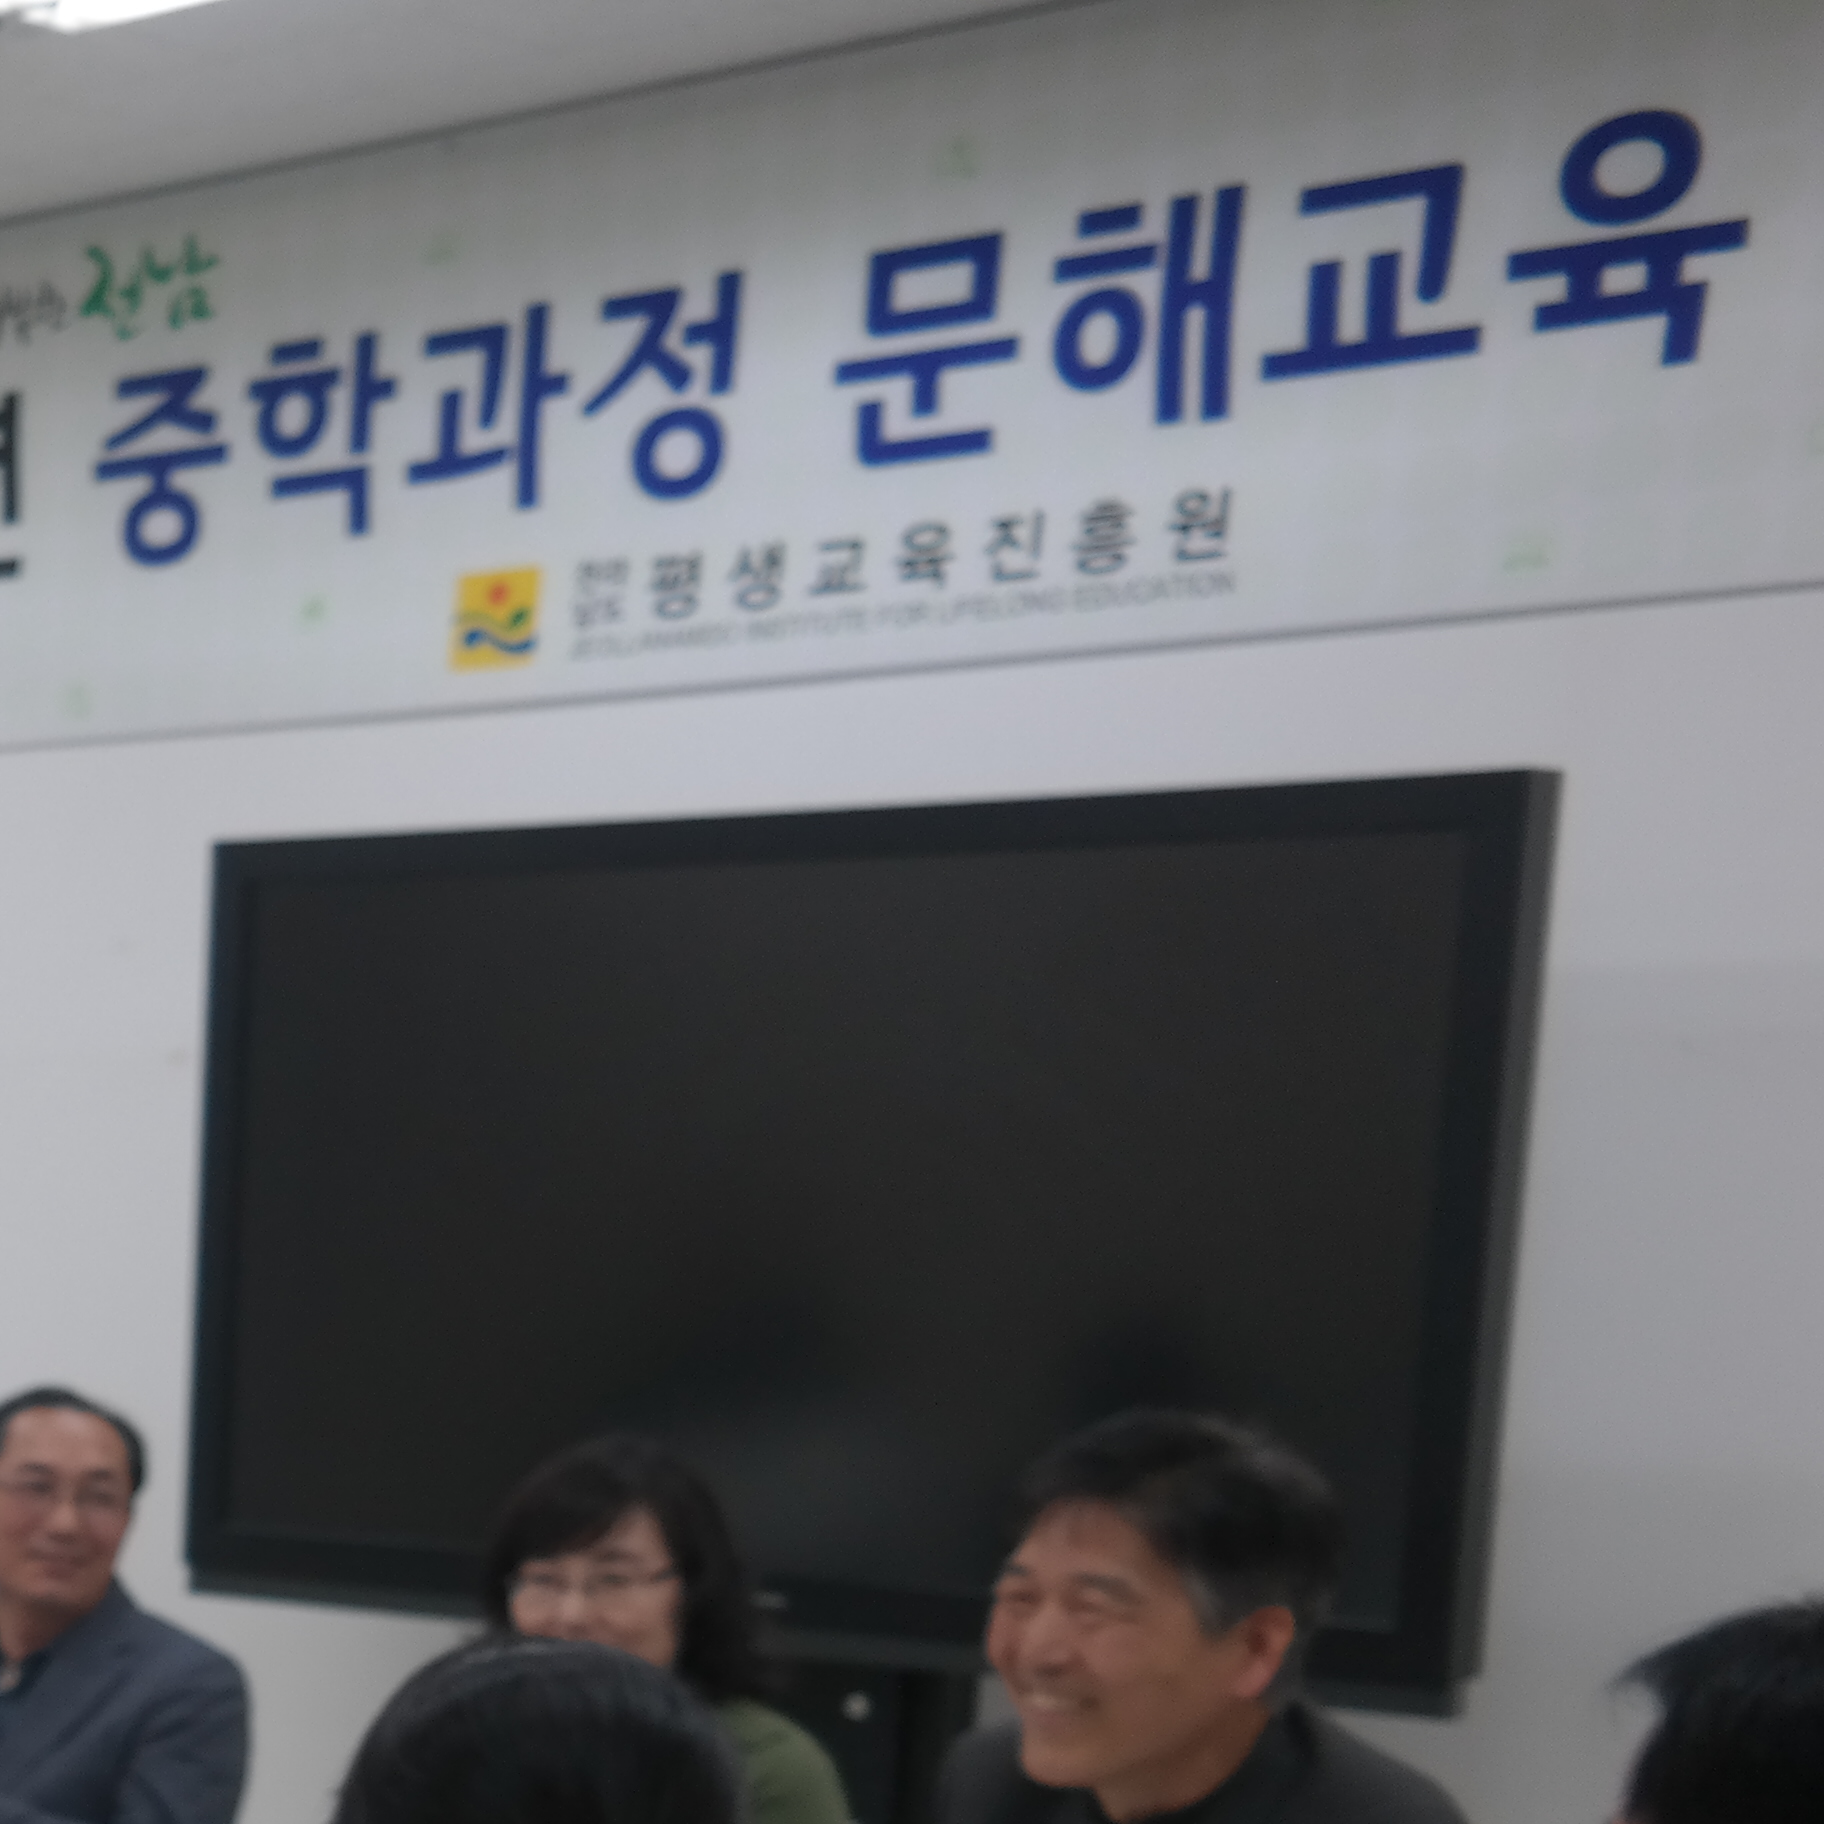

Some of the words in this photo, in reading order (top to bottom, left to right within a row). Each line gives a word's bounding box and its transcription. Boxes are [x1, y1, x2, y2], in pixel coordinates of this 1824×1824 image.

[93, 271, 744, 567] 중학과정
[834, 108, 1750, 468] 문해교육
[649, 487, 1232, 620] 평생교육진흥원
